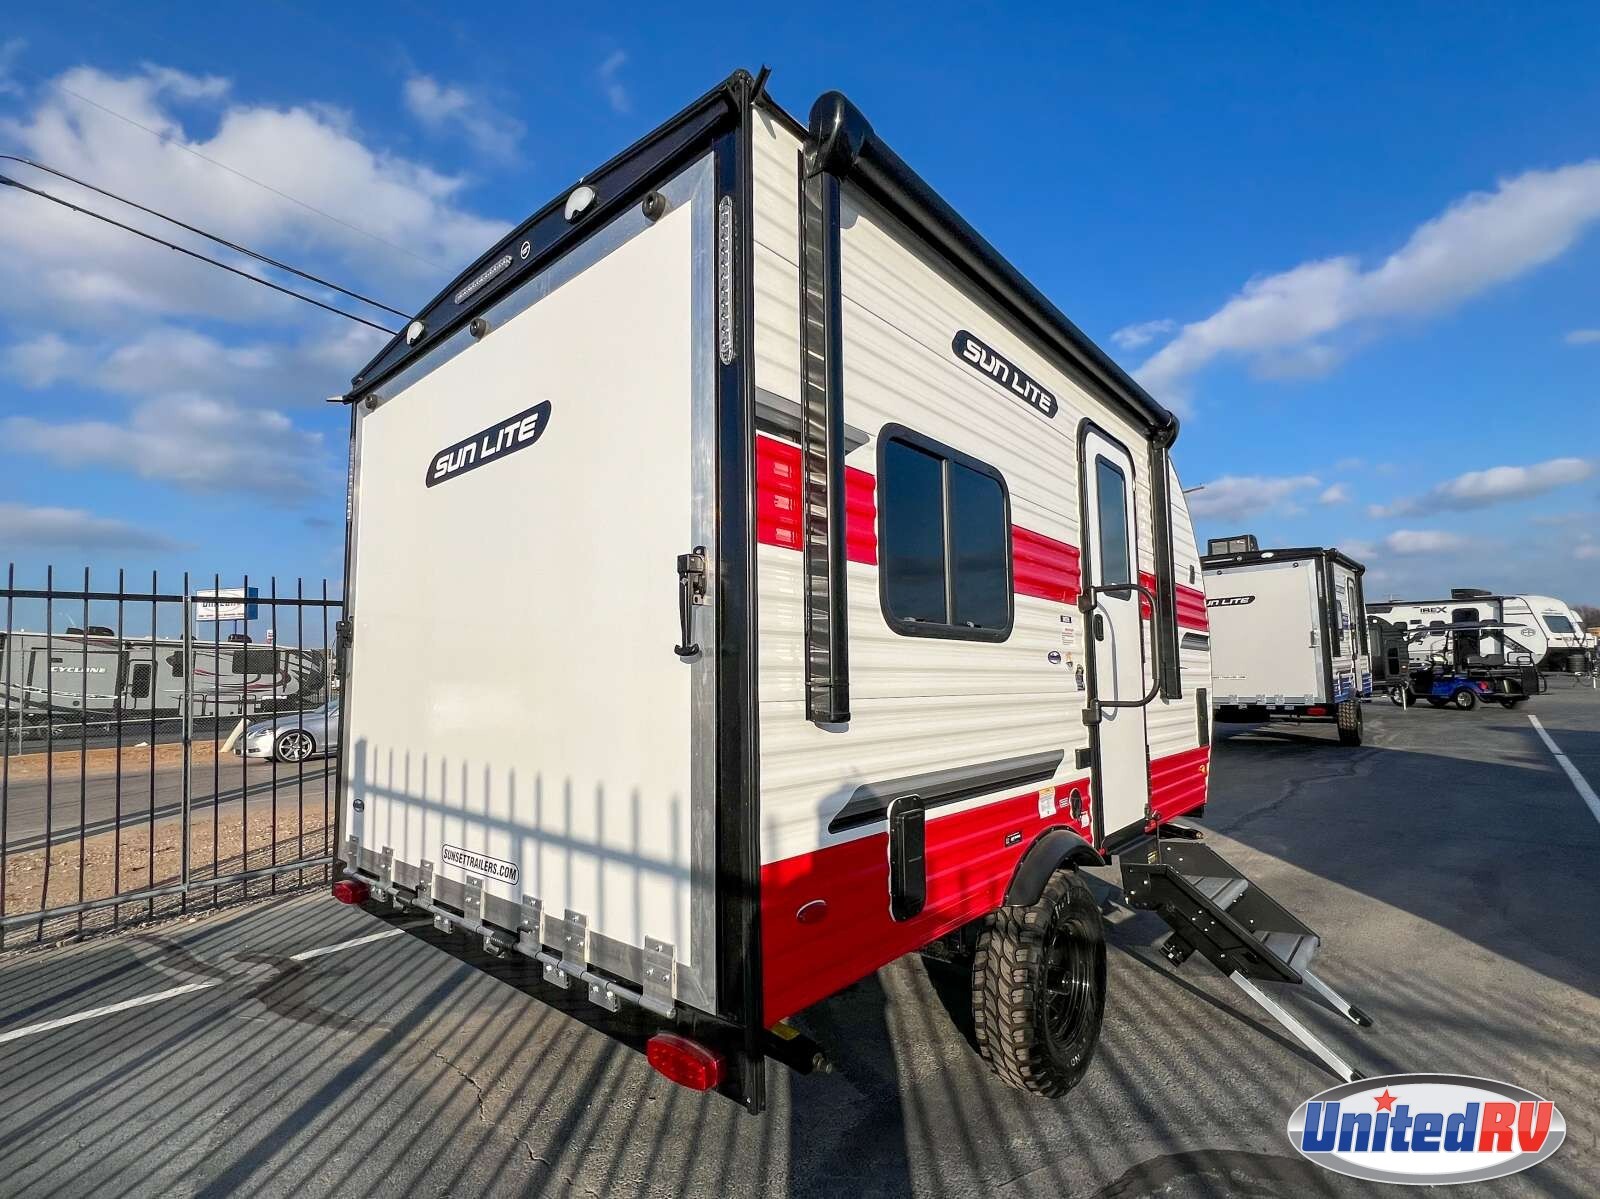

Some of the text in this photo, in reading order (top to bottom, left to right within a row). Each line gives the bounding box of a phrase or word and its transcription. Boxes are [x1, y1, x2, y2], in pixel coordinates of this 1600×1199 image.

[963, 339, 1052, 413] SUN LITE
[433, 412, 539, 479] SUN LITE
[1221, 597, 1250, 605] LITE
[443, 848, 517, 881] SUNSETTRAILERS.COM
